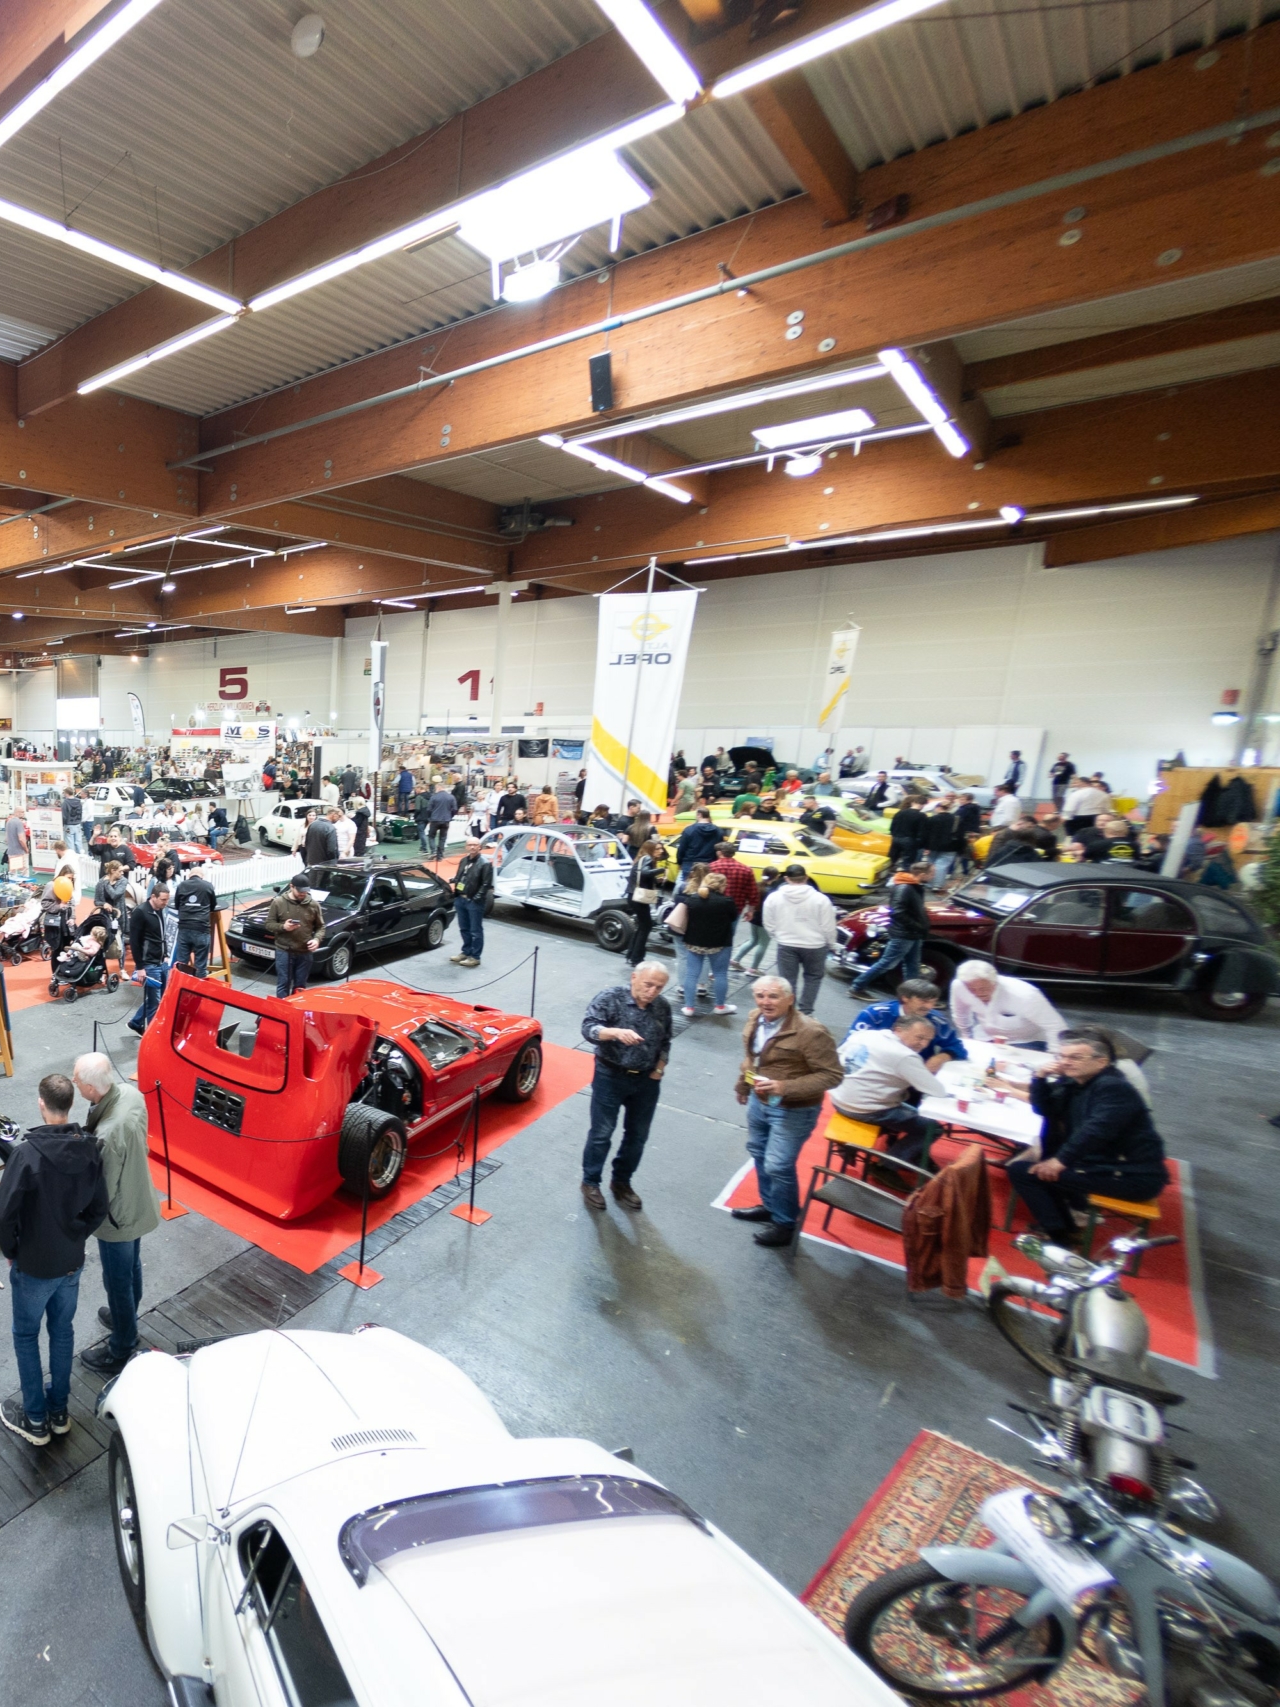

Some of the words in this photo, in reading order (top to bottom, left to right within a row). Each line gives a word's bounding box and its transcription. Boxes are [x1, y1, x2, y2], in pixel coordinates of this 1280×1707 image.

[218, 666, 248, 700] 5
[457, 669, 480, 701] 1
[224, 725, 270, 736] MAS
